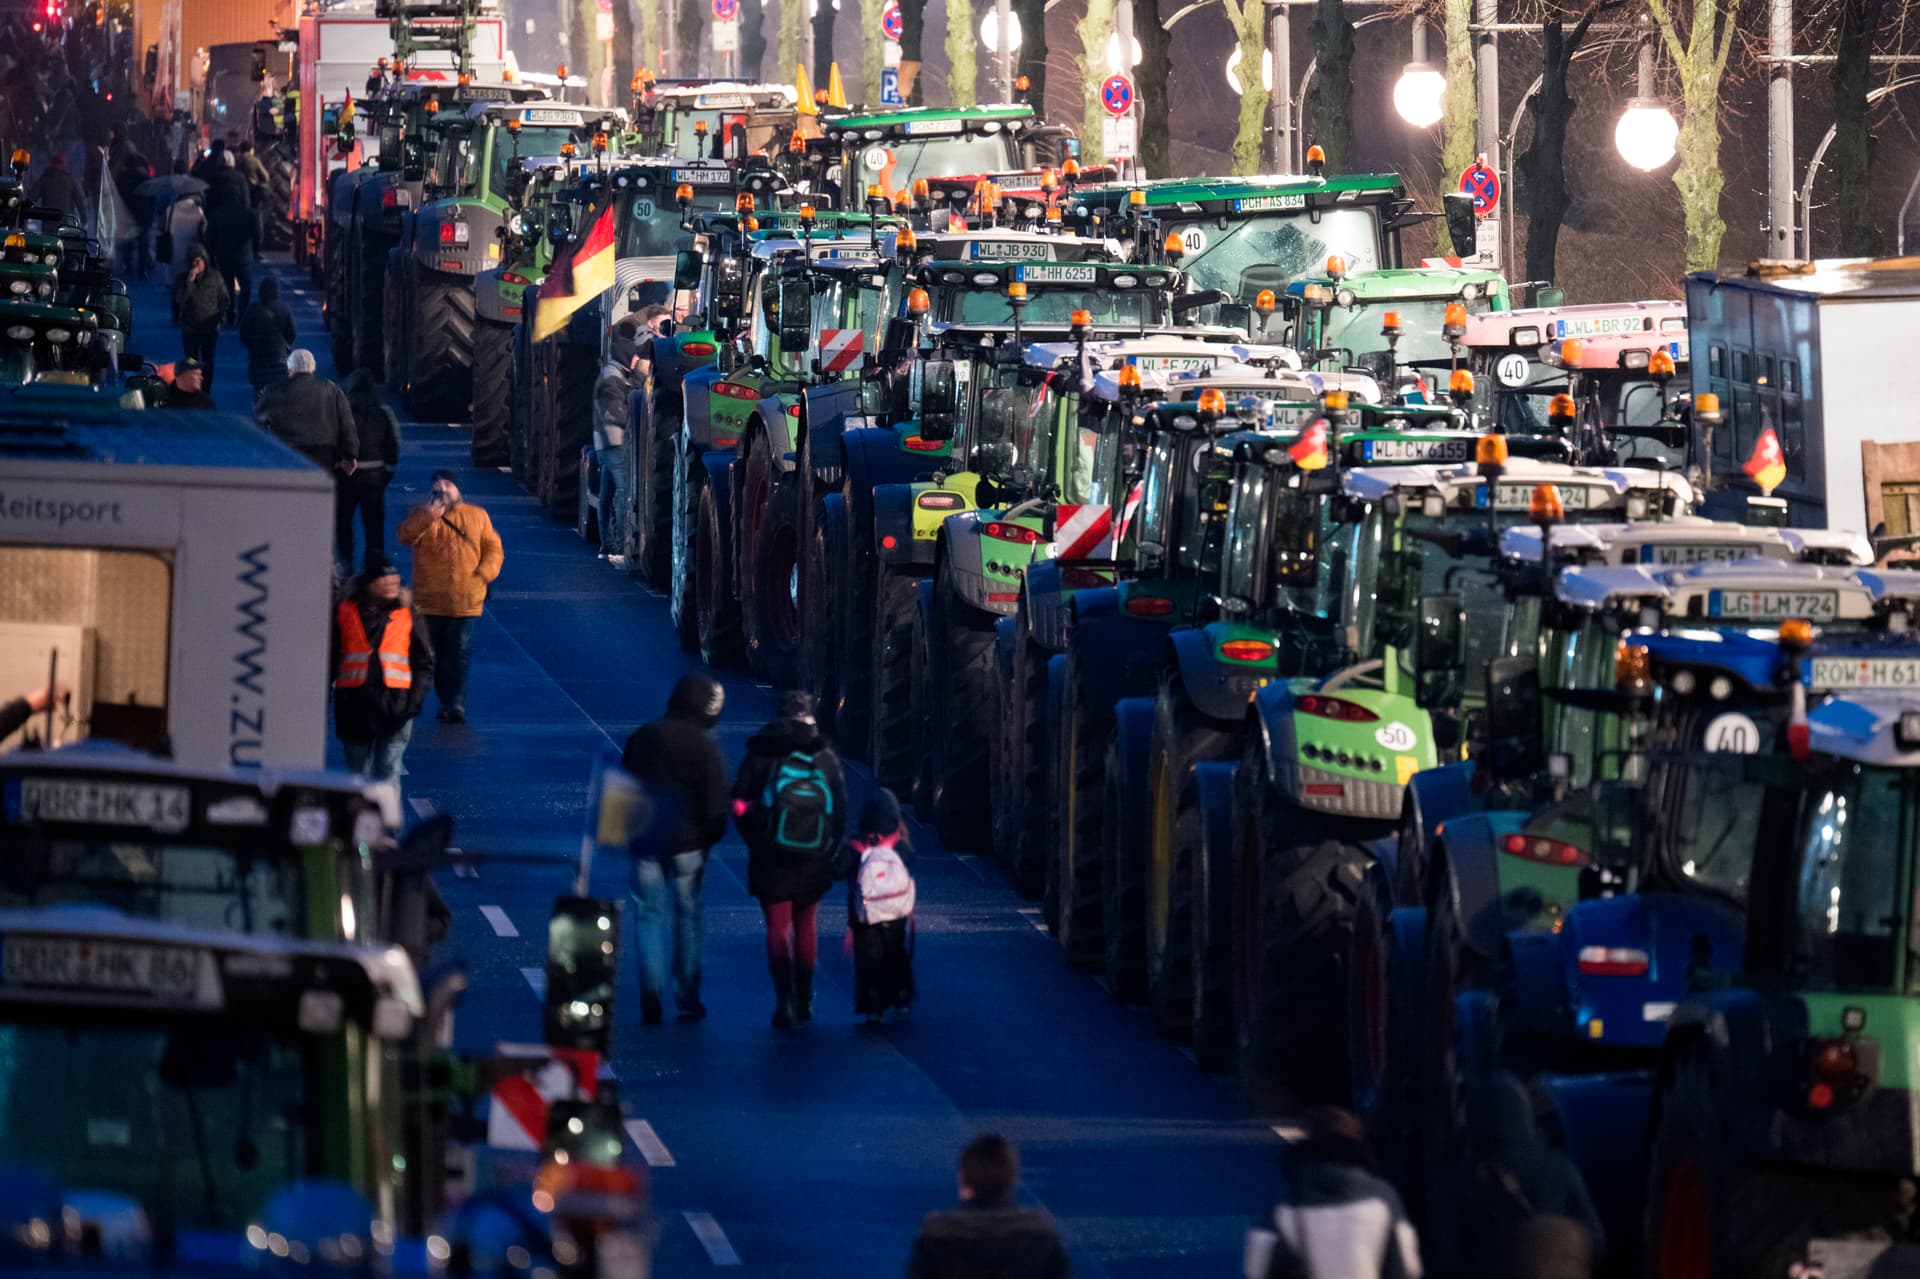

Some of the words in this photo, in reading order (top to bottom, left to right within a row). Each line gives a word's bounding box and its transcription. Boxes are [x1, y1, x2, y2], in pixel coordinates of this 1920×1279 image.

[884, 75, 899, 100] P
[871, 153, 883, 166] 40
[677, 171, 690, 181] WL
[711, 171, 729, 182] 170
[637, 202, 651, 215] 50
[1242, 199, 1263, 210] PCH
[1269, 198, 1283, 208] AS
[1285, 195, 1304, 207] 834
[1185, 233, 1201, 251] 40
[979, 245, 996, 257] WL
[1003, 245, 1021, 258] JB
[1023, 245, 1046, 259] 930
[1023, 267, 1039, 280] WL
[1047, 267, 1063, 281] HH
[1066, 267, 1095, 282] 6251
[1566, 321, 1593, 336] LWL
[1601, 319, 1620, 334] BR
[1622, 317, 1641, 333] 92
[1504, 360, 1524, 380] 40
[1274, 409, 1295, 425] WL
[1375, 440, 1393, 457] WL
[1405, 441, 1424, 458] CW
[1428, 442, 1466, 459] 6155
[1722, 595, 1750, 616] LG
[1762, 596, 1791, 616] LM
[1793, 597, 1834, 616] 724
[1815, 663, 1857, 685] ROW
[1872, 662, 1888, 683] H
[1383, 726, 1408, 746] 50
[1717, 724, 1746, 752] 40
